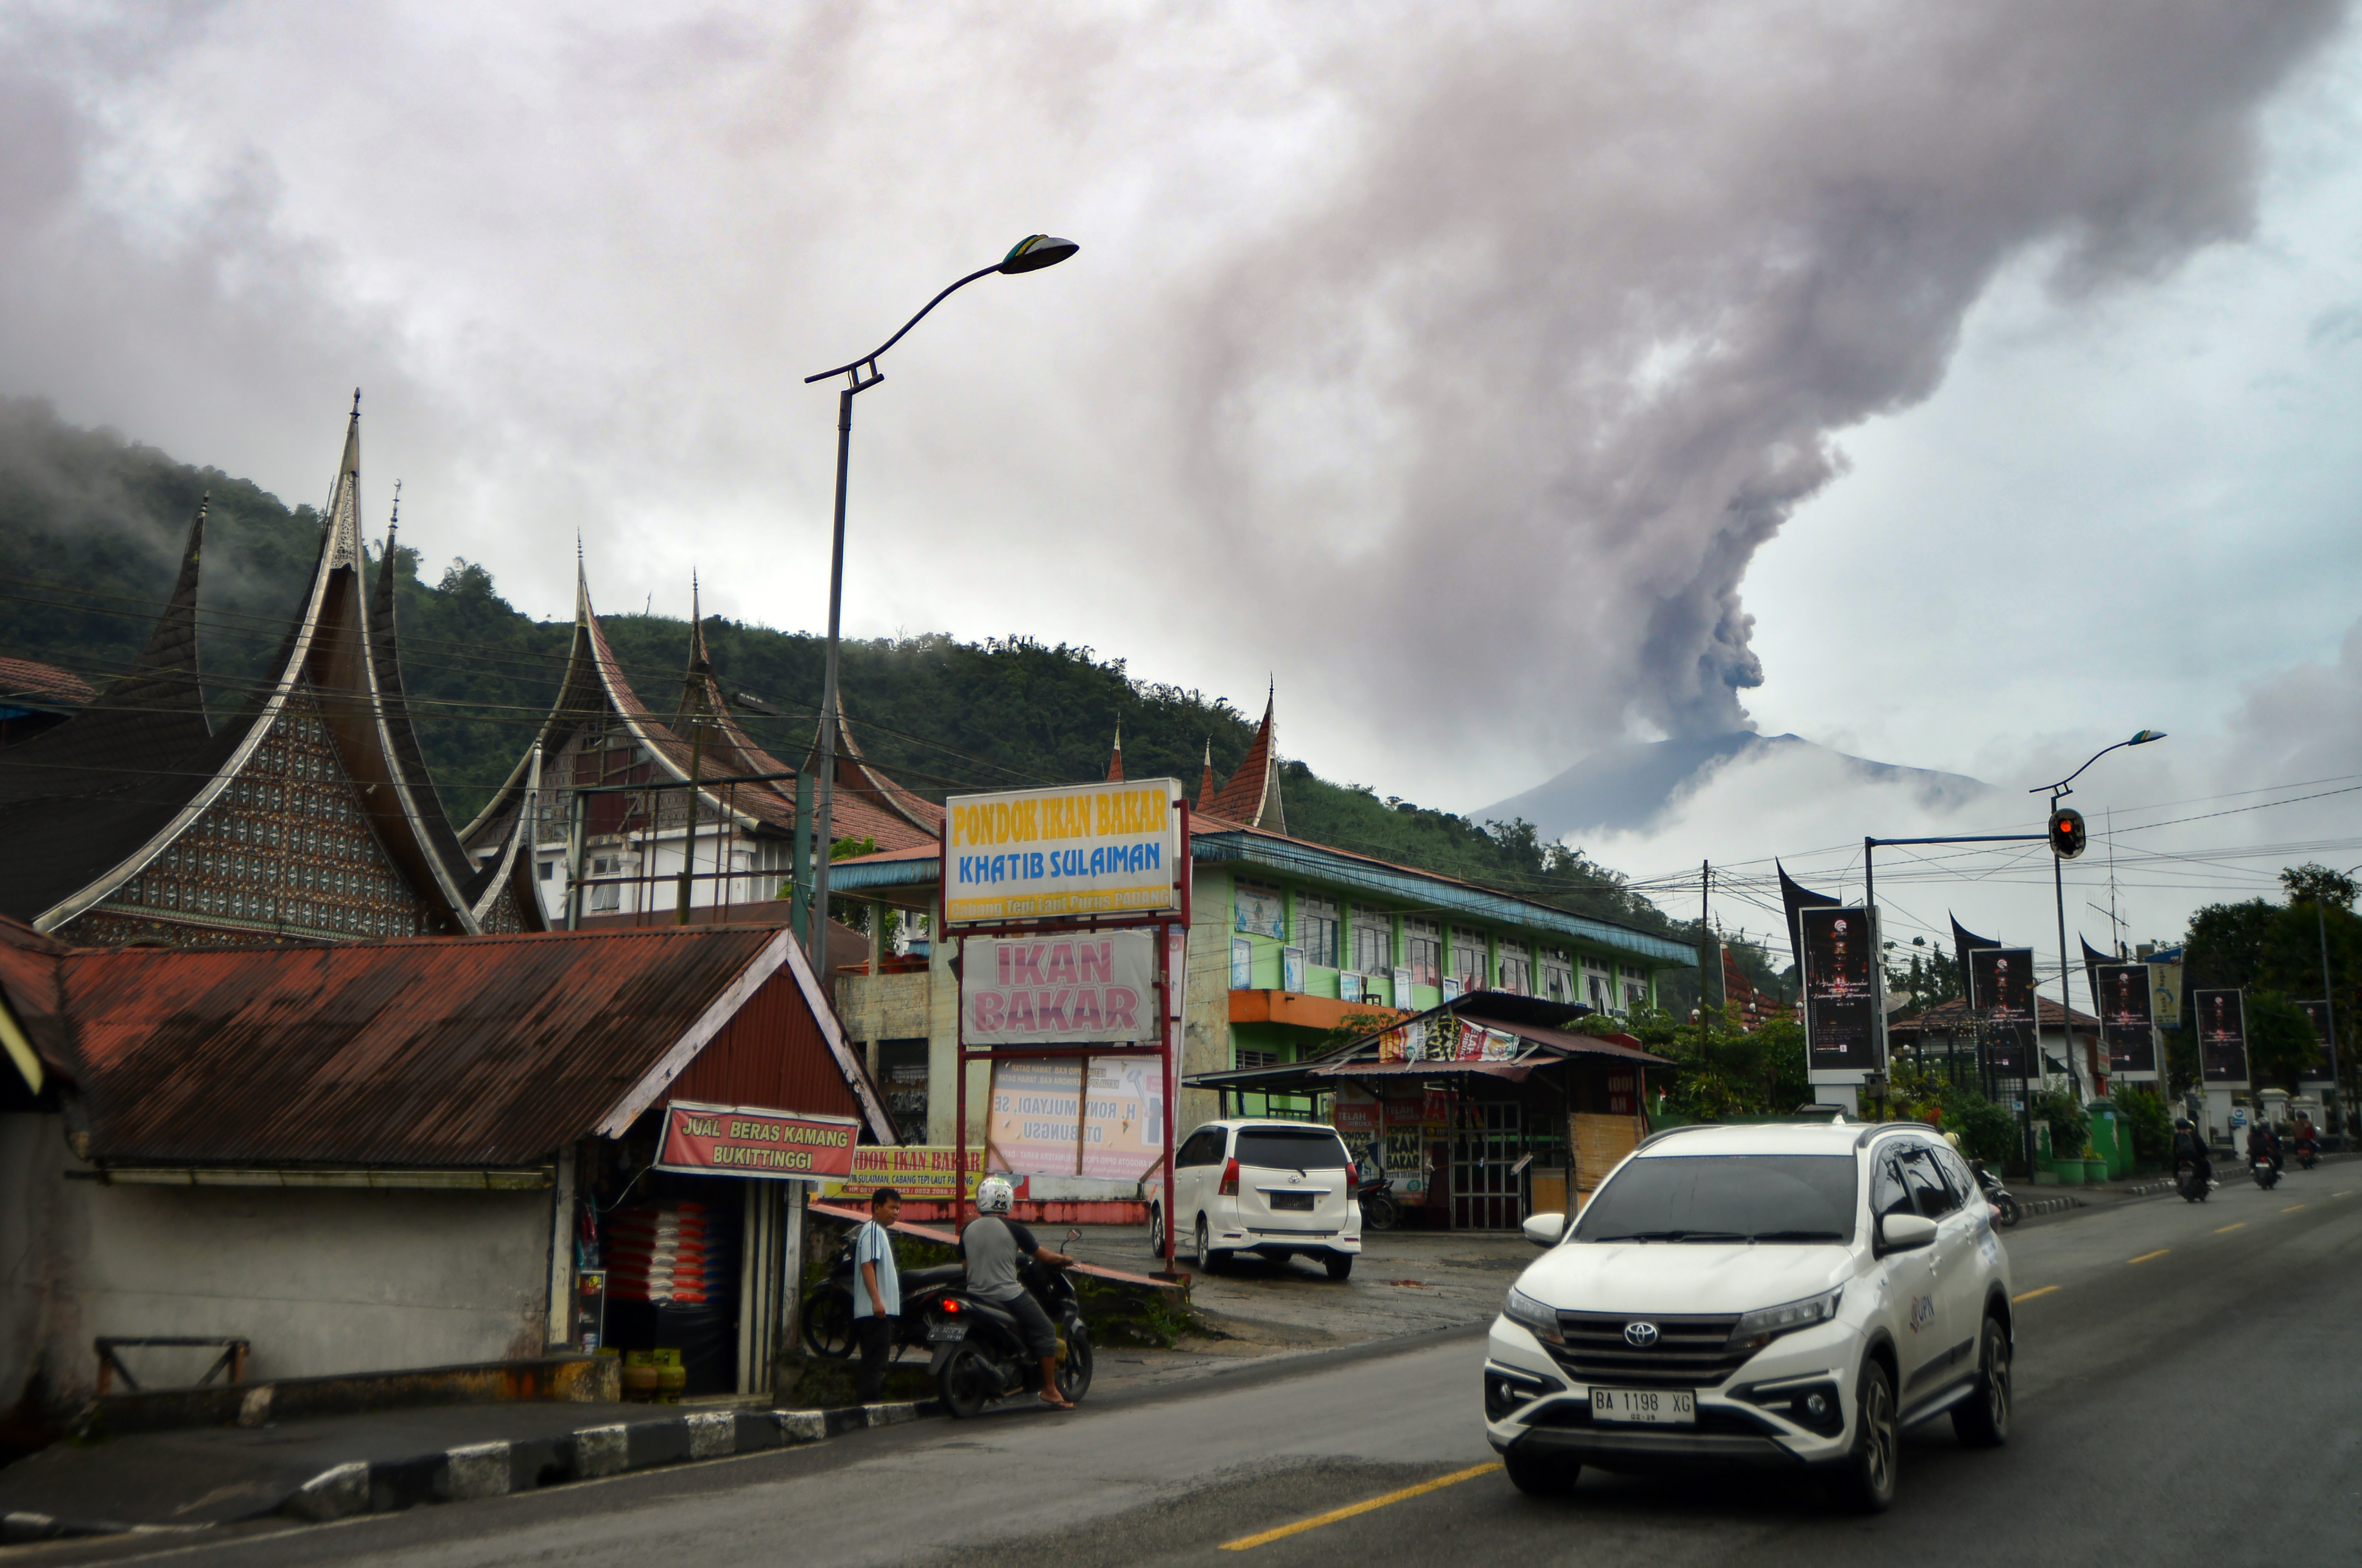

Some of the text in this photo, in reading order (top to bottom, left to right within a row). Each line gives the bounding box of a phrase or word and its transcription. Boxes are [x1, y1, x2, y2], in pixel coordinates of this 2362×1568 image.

[952, 789, 1167, 847] PONDOK IKAN BAKAR
[959, 842, 1160, 885] KHATIB SULAIMAN
[951, 888, 1170, 917] Cabang Tepi Laut Purus PADANG
[997, 940, 1113, 987] IKAN
[973, 986, 1139, 1034] BAKAR
[1465, 1028, 1479, 1055] ELAH
[1338, 1113, 1366, 1121] TELAH
[1386, 1106, 1413, 1115] TELAH
[682, 1118, 848, 1148] JUAL BERAS KAMANG
[1386, 1125, 1419, 1134] PONDOK
[1386, 1135, 1419, 1155] IKAN
[713, 1146, 812, 1169] BUKITTINGGI
[893, 1151, 926, 1171] IKAN
[1386, 1155, 1420, 1171] BAKAR
[858, 1175, 890, 1184] SULAIMAN,
[892, 1175, 916, 1184] CABANG
[918, 1175, 929, 1184] TEPI
[931, 1175, 946, 1185] LAUT
[948, 1176, 973, 1185] PANG
[1918, 1293, 1934, 1321] UPN
[1596, 1391, 1690, 1412] BA 1198 XG
